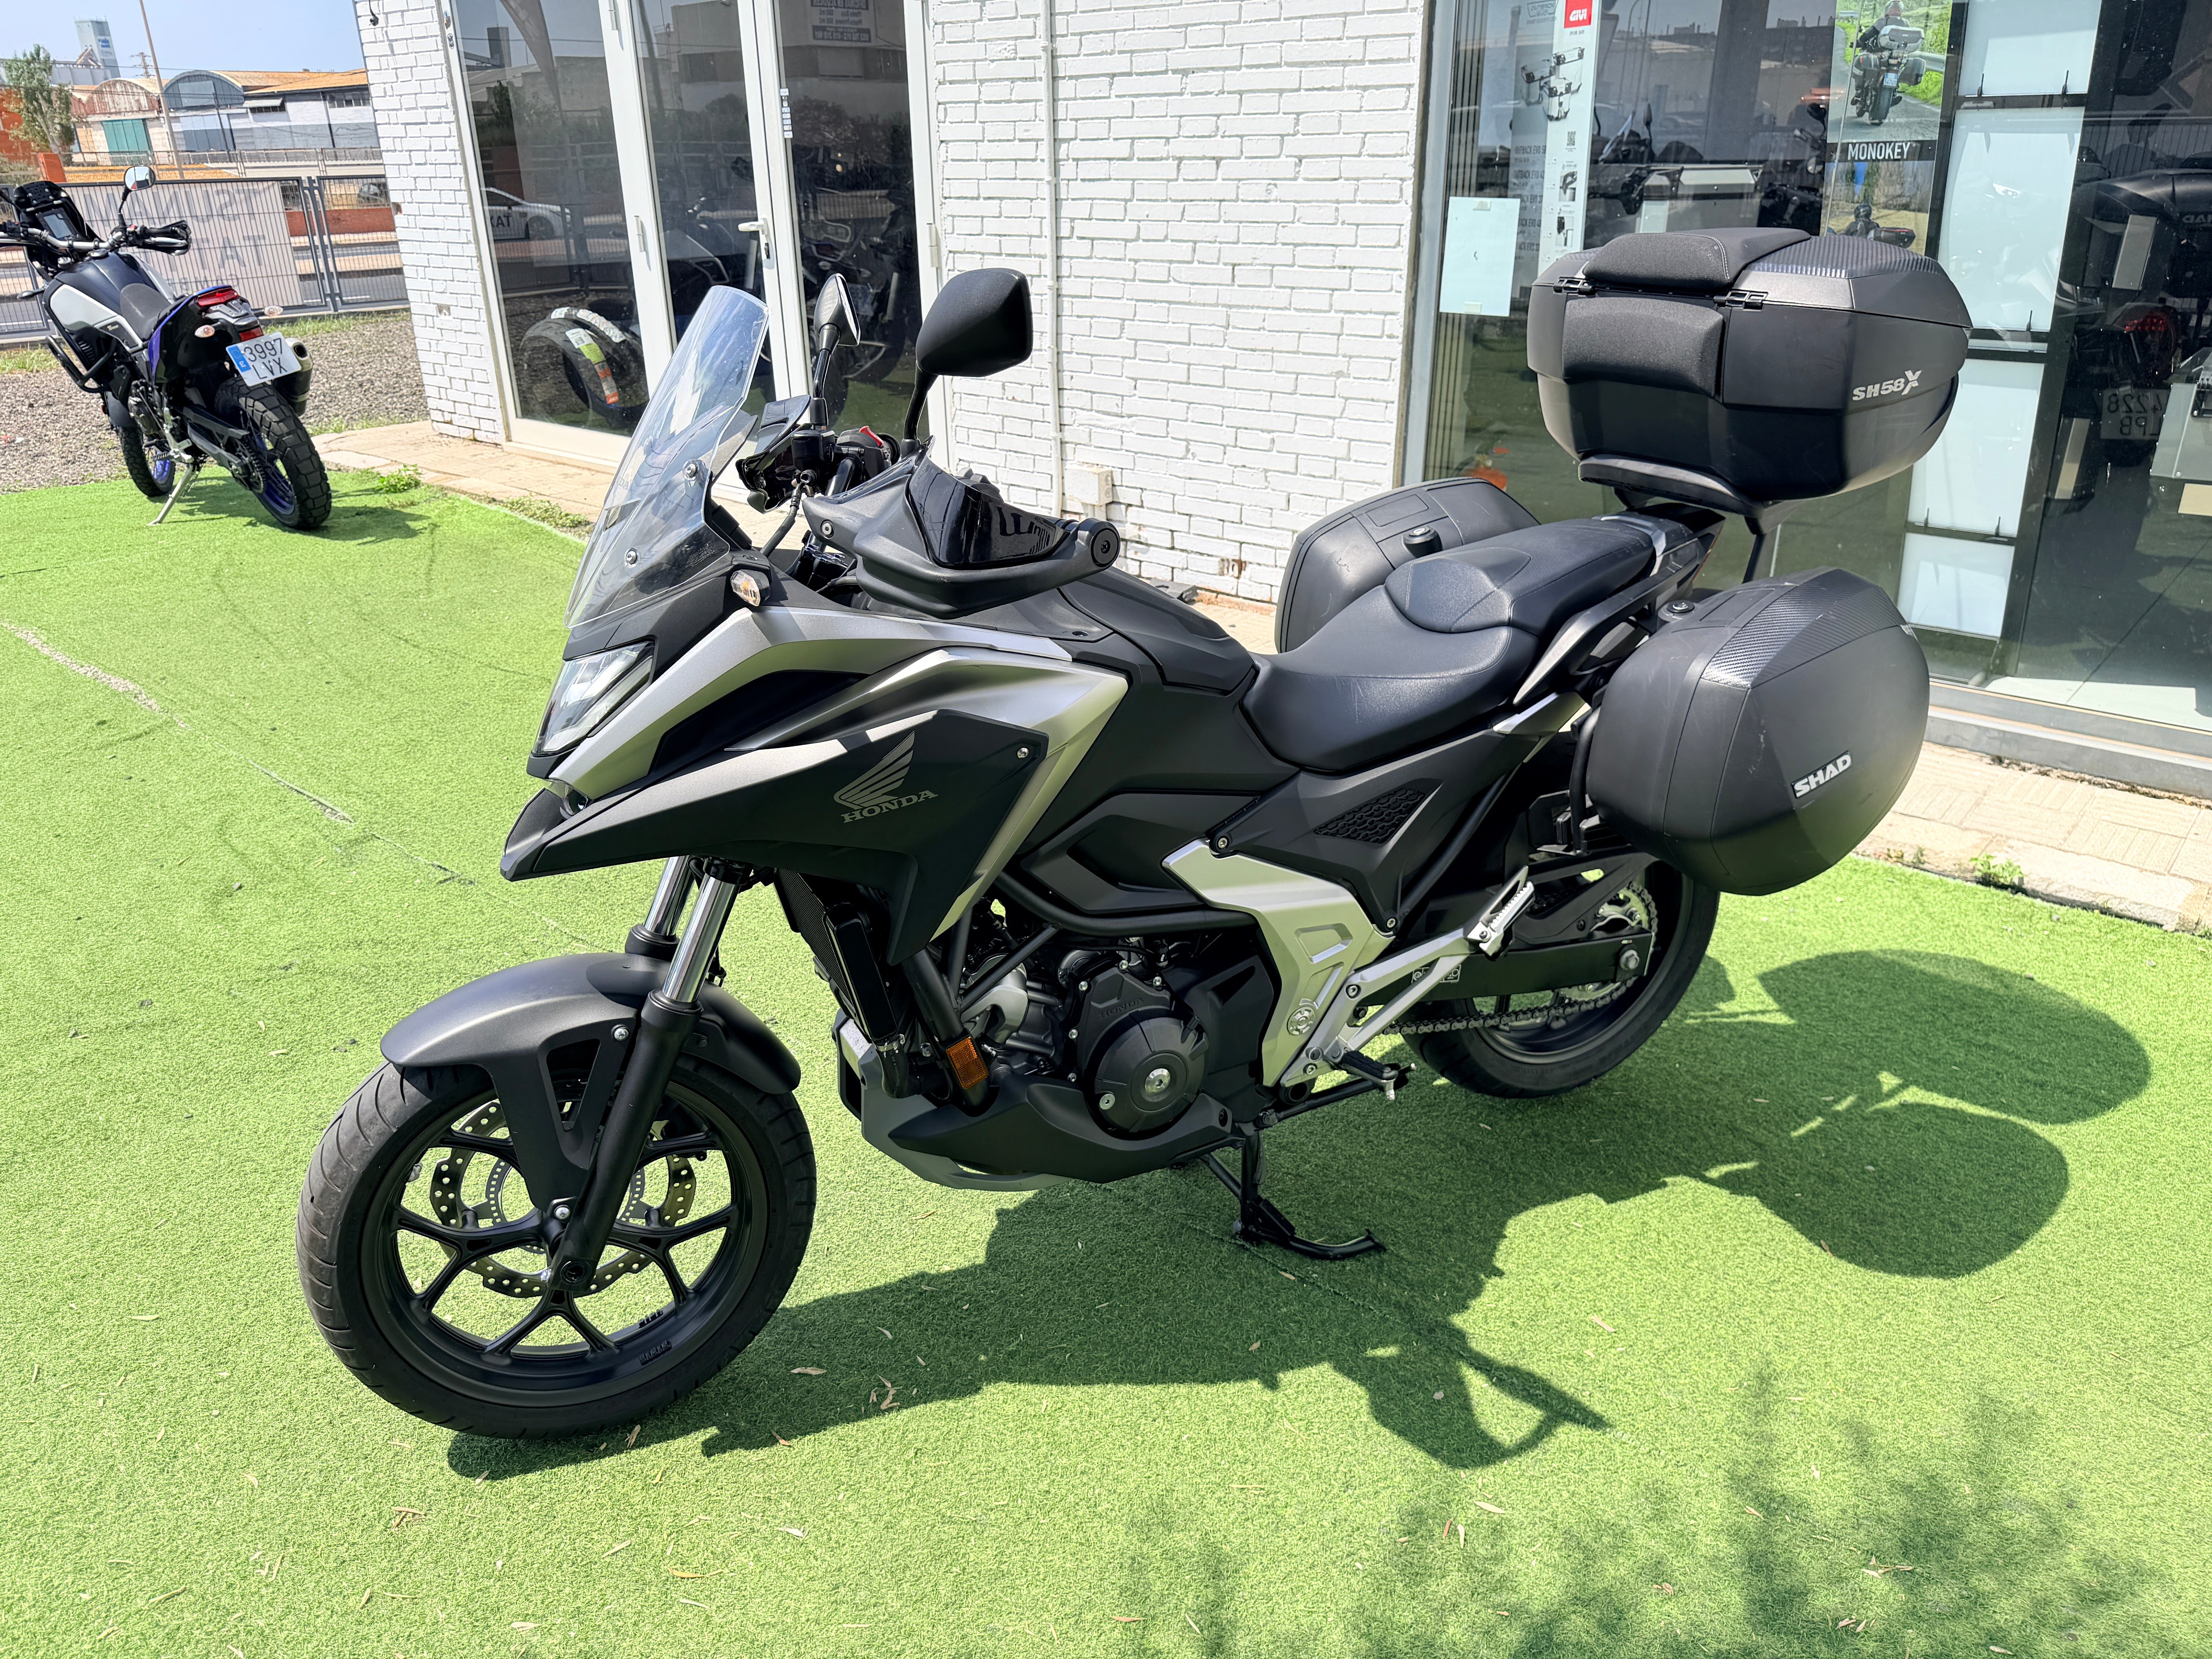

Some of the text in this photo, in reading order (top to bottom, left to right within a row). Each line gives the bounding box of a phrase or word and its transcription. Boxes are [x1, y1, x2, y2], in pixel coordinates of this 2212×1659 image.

[1570, 9, 1587, 21] GIVI
[1848, 142, 1911, 160] MONOKEY
[244, 338, 282, 362] 3997
[252, 357, 287, 379] LVX
[1794, 755, 1851, 797] SHAD
[841, 790, 938, 823] HONDA
[1101, 998, 1144, 1018] HONDA
